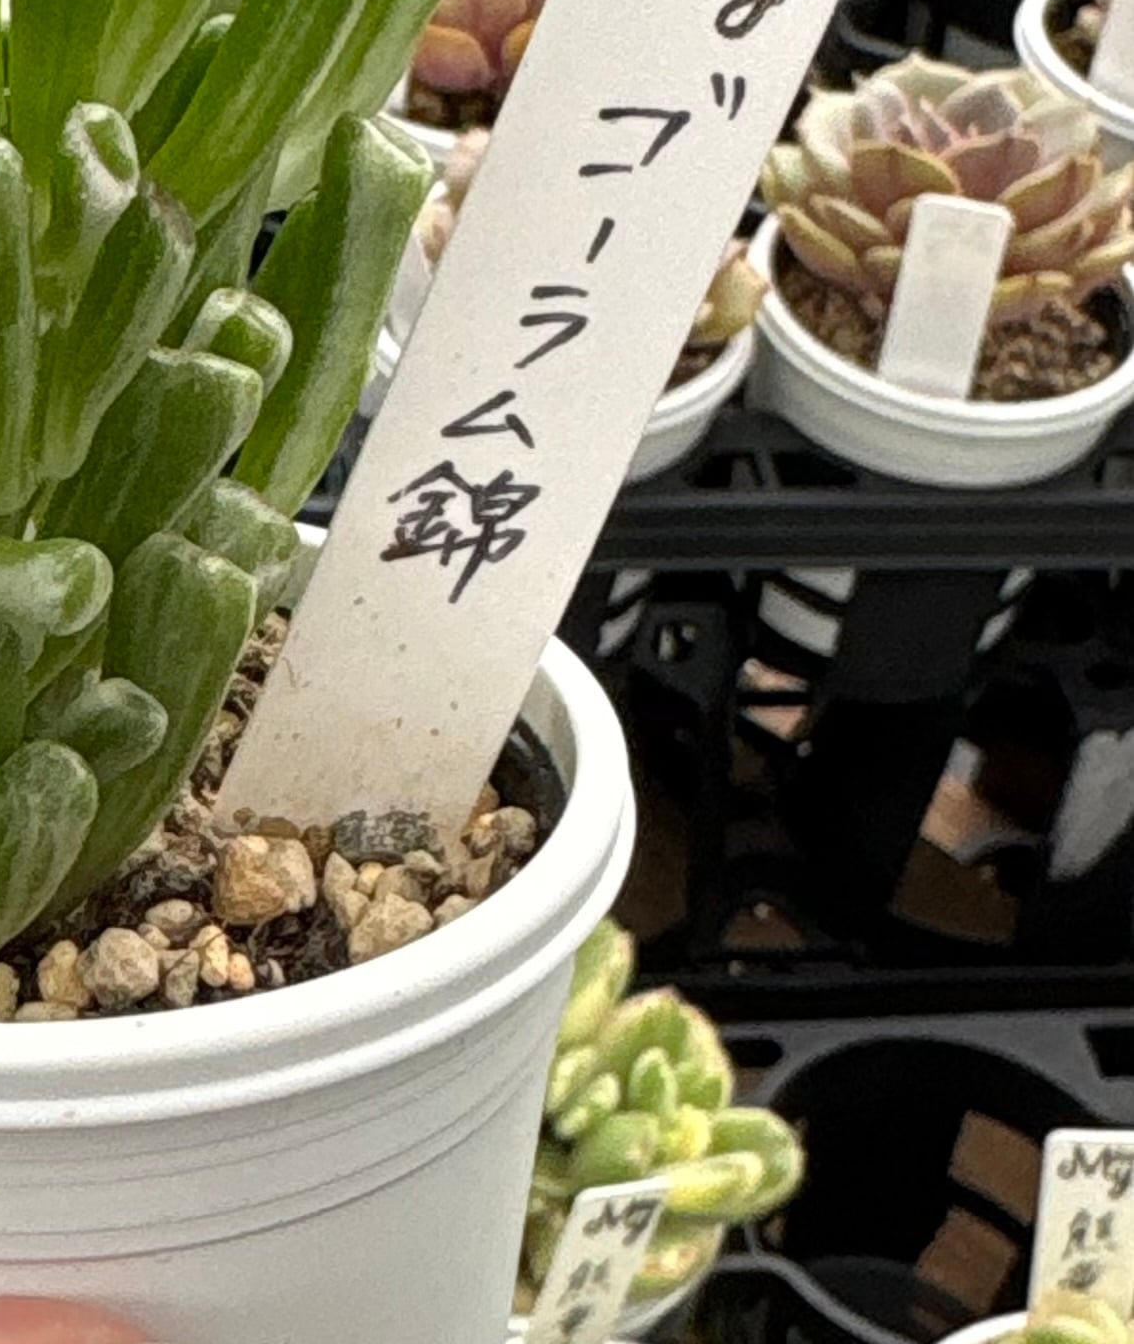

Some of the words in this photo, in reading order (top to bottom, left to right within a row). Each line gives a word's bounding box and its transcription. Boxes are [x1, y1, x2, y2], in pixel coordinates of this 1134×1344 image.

[380, 73, 745, 604] ゴーラム錦
